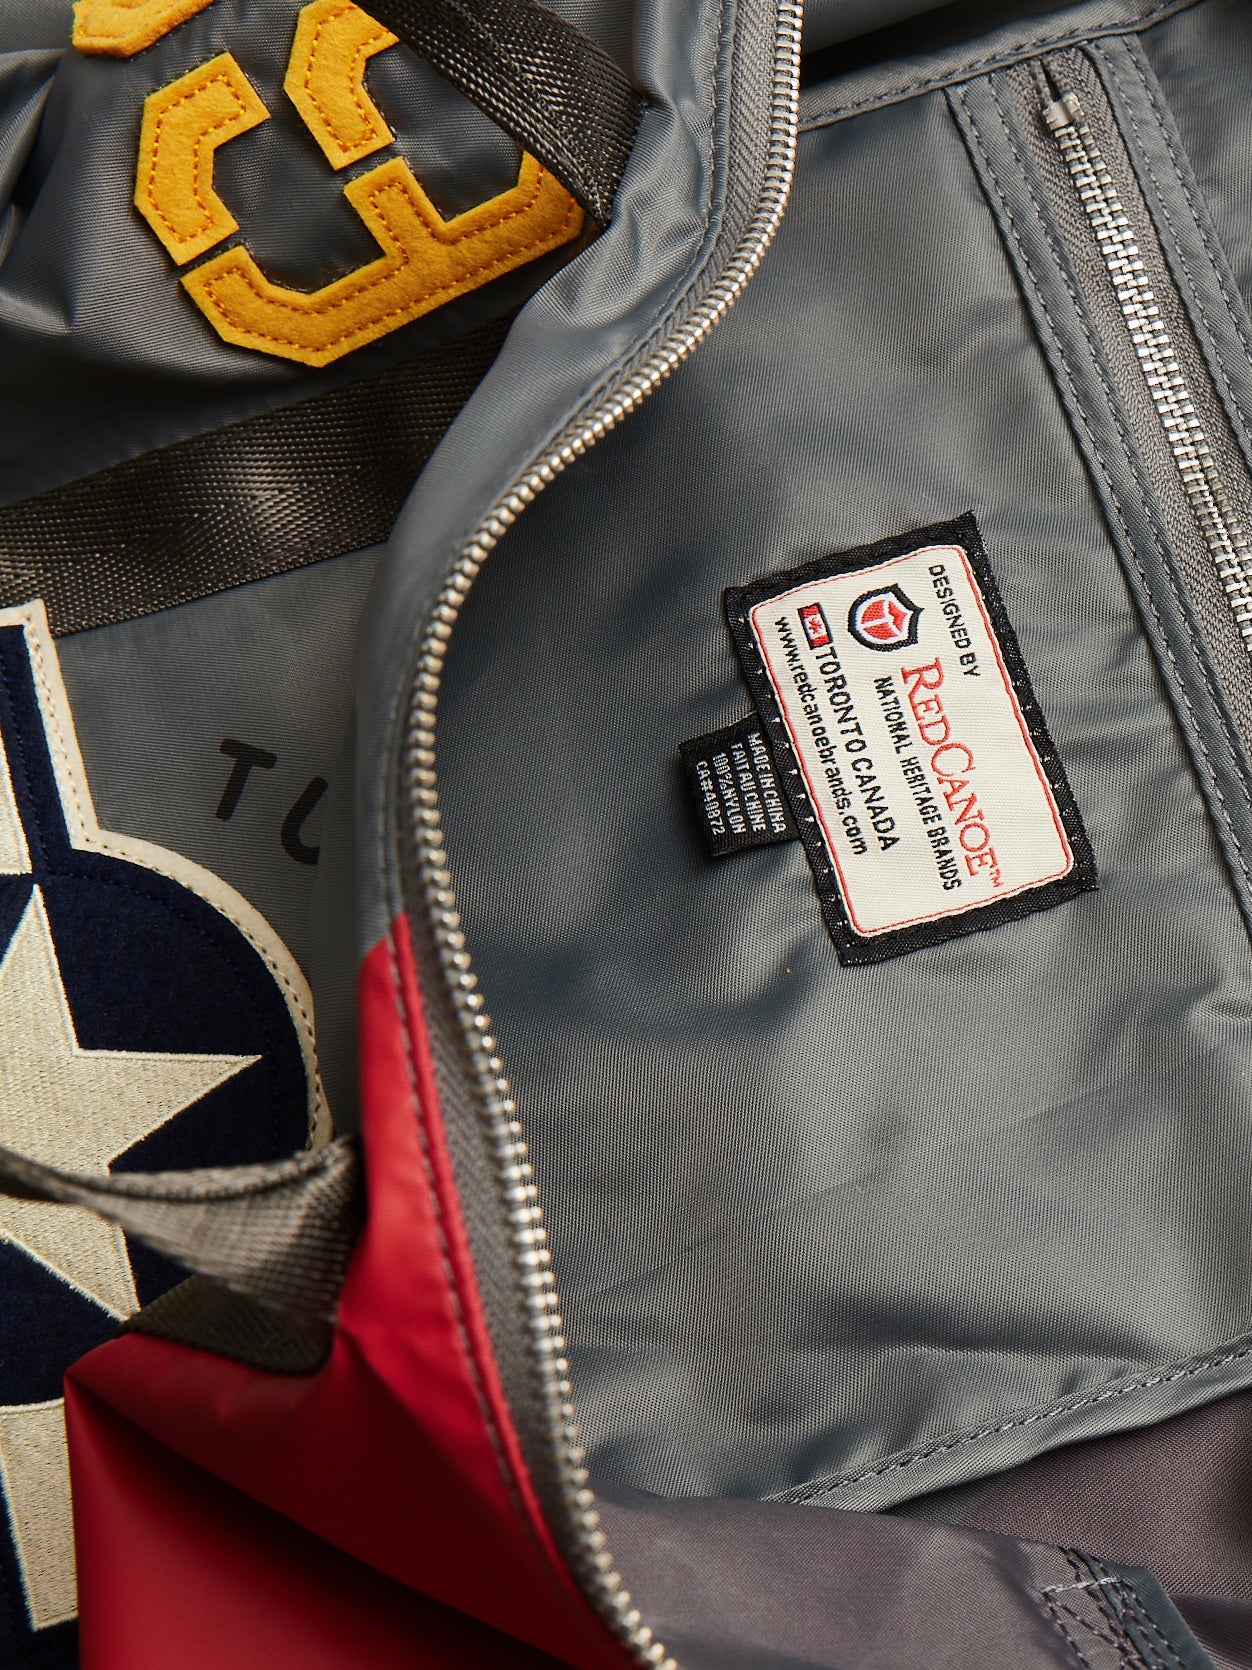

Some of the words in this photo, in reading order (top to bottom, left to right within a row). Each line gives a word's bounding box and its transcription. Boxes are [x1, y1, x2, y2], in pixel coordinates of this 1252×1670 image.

[929, 565, 972, 648] DESIGNED
[960, 652, 981, 676] BY
[747, 731, 771, 772] MADE
[775, 617, 867, 854] www.redcanoebrands.com
[815, 647, 867, 752] TORONTO
[852, 758, 900, 851] CANADA
[731, 743, 749, 770] FAIT
[739, 772, 756, 791] AU
[759, 774, 775, 788] IN
[874, 676, 912, 754] NATIONAL
[900, 757, 942, 825] HERITAGE
[927, 826, 962, 890] BRANDS
[745, 792, 766, 832] CHINE
[763, 791, 786, 833] CHINA
